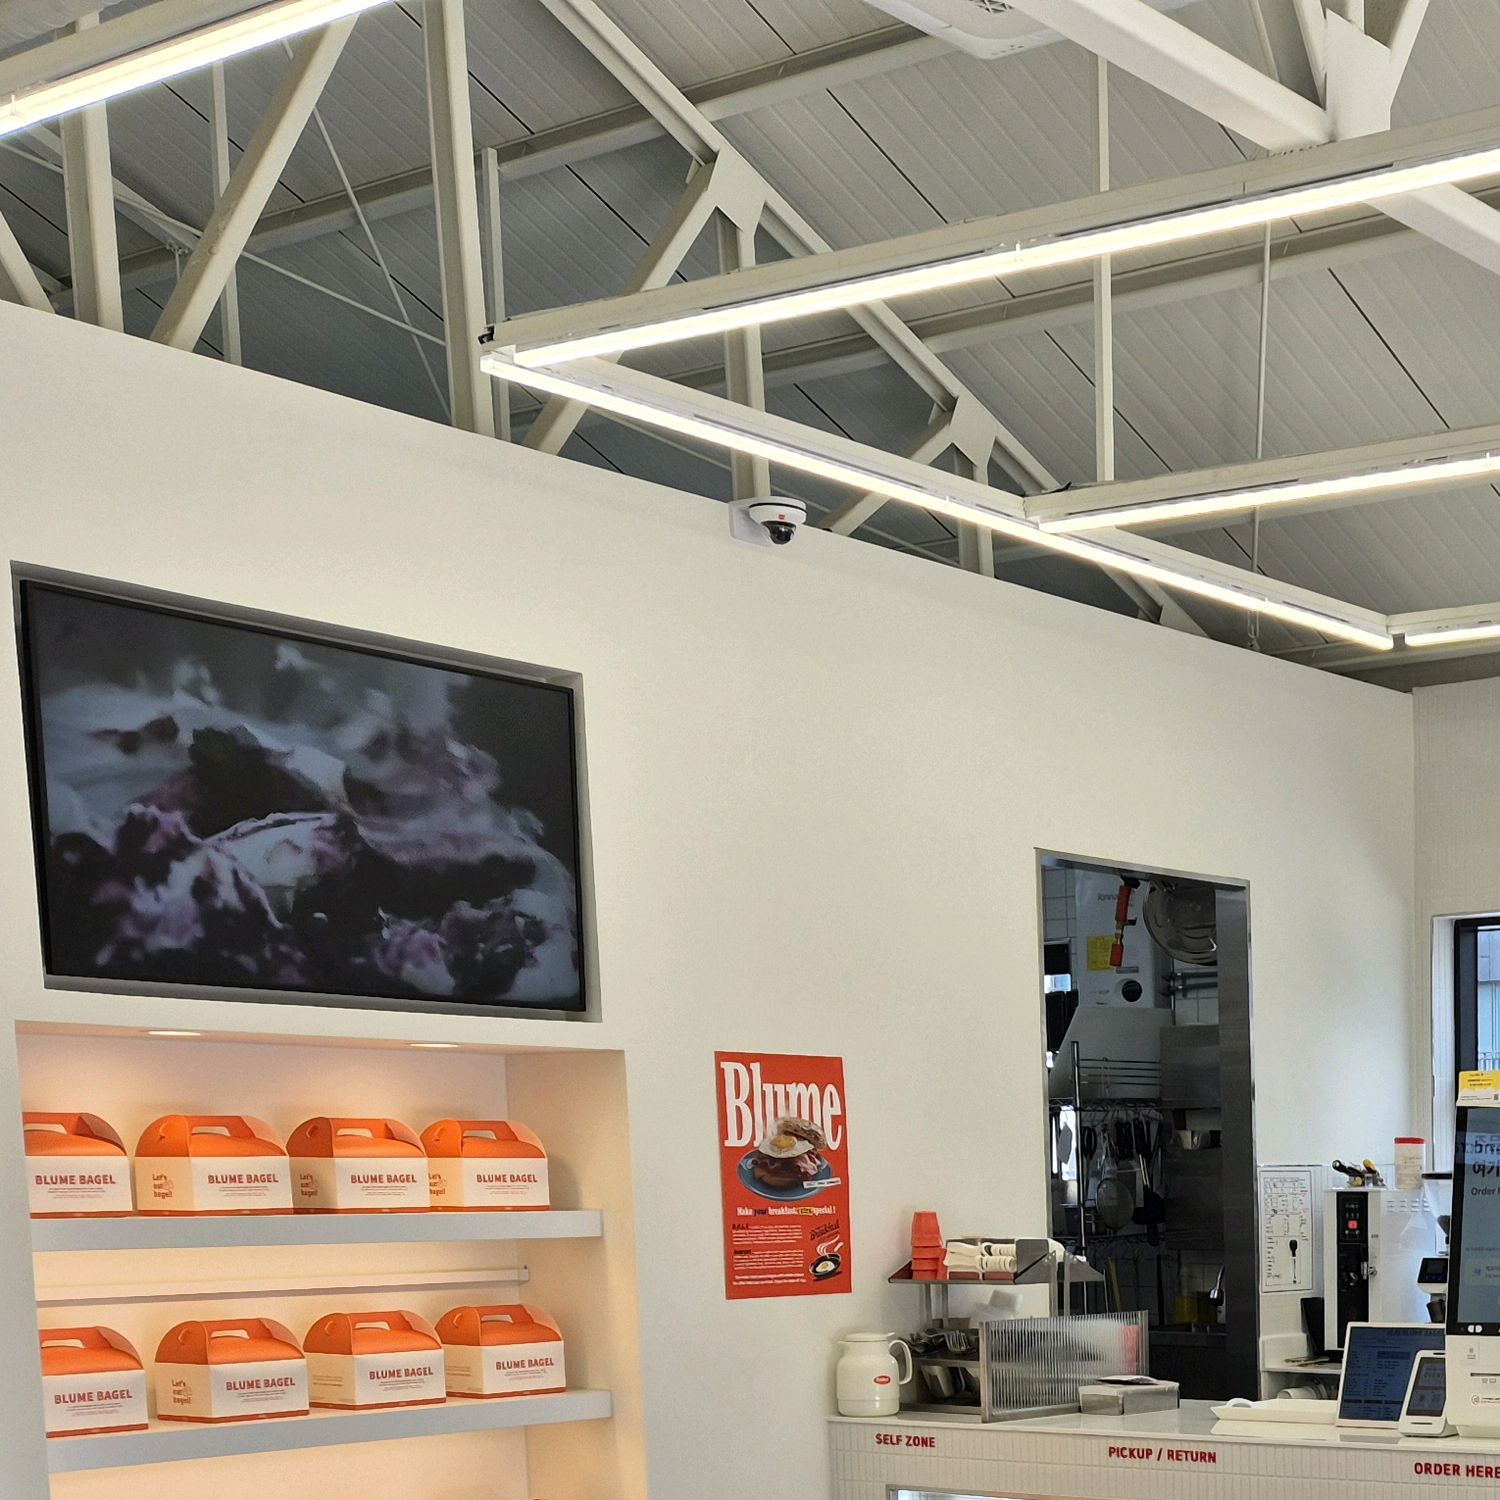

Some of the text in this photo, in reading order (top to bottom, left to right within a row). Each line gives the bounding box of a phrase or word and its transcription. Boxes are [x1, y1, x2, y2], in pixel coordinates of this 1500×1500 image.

[720, 1061, 842, 1150] Blume
[36, 1175, 116, 1185] BLUME BAGEL
[208, 1174, 278, 1184] BLUME BAGEL
[351, 1175, 416, 1184] BLUME BAGEL
[477, 1174, 537, 1183] BLUME BAGEL
[1471, 1187, 1495, 1196] Order
[496, 1358, 554, 1371] BLUME BAGEL
[369, 1366, 433, 1380] BLUME BAGEL
[226, 1377, 296, 1391] BLUME BAGEL
[54, 1389, 133, 1404] BLUME BAGEL
[875, 1432, 936, 1448] SELF ZONE
[1108, 1445, 1152, 1460] PICKUP
[1167, 1448, 1217, 1464] RETURN
[1414, 1462, 1461, 1477] ORDER
